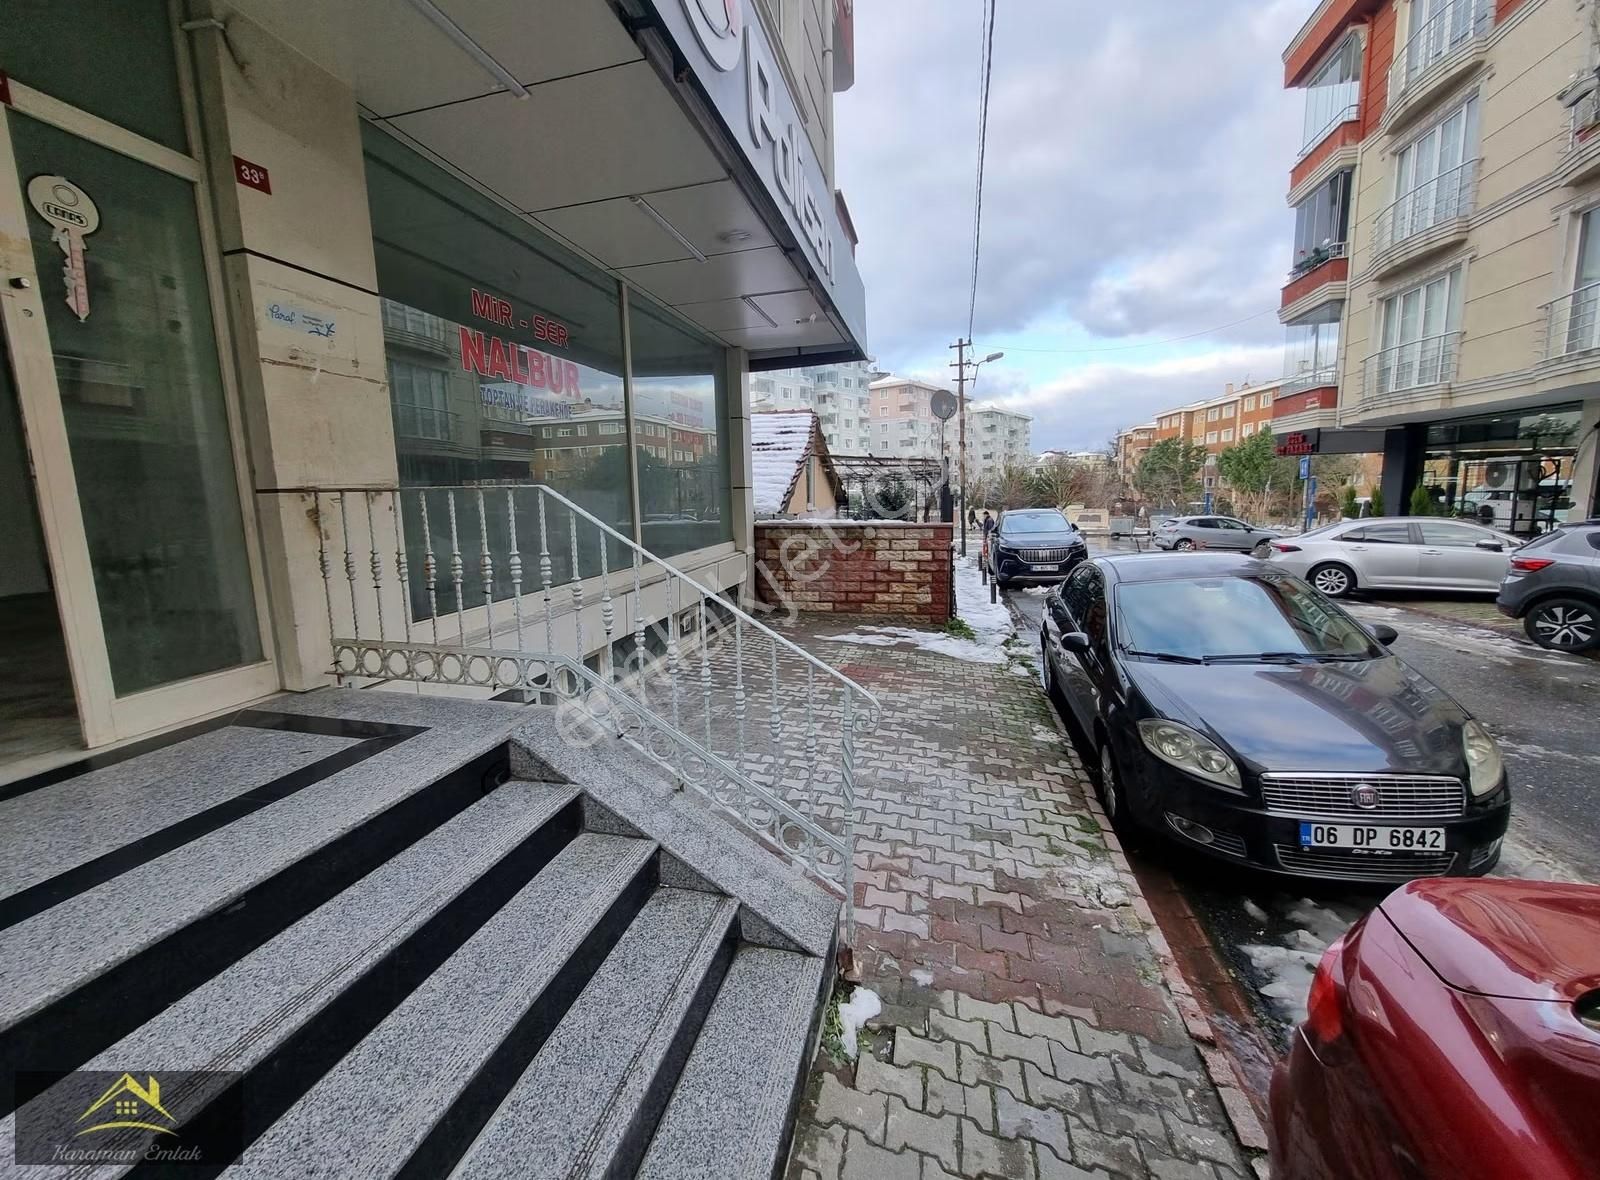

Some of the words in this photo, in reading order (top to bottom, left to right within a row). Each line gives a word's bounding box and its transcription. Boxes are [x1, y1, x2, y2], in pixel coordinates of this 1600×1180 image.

[533, 314, 569, 350] SER
[459, 325, 581, 402] NALBUR
[1360, 792, 1374, 803] FIAT
[1313, 826, 1338, 845] 06
[1352, 827, 1378, 846] DP
[1389, 829, 1441, 848] 6842
